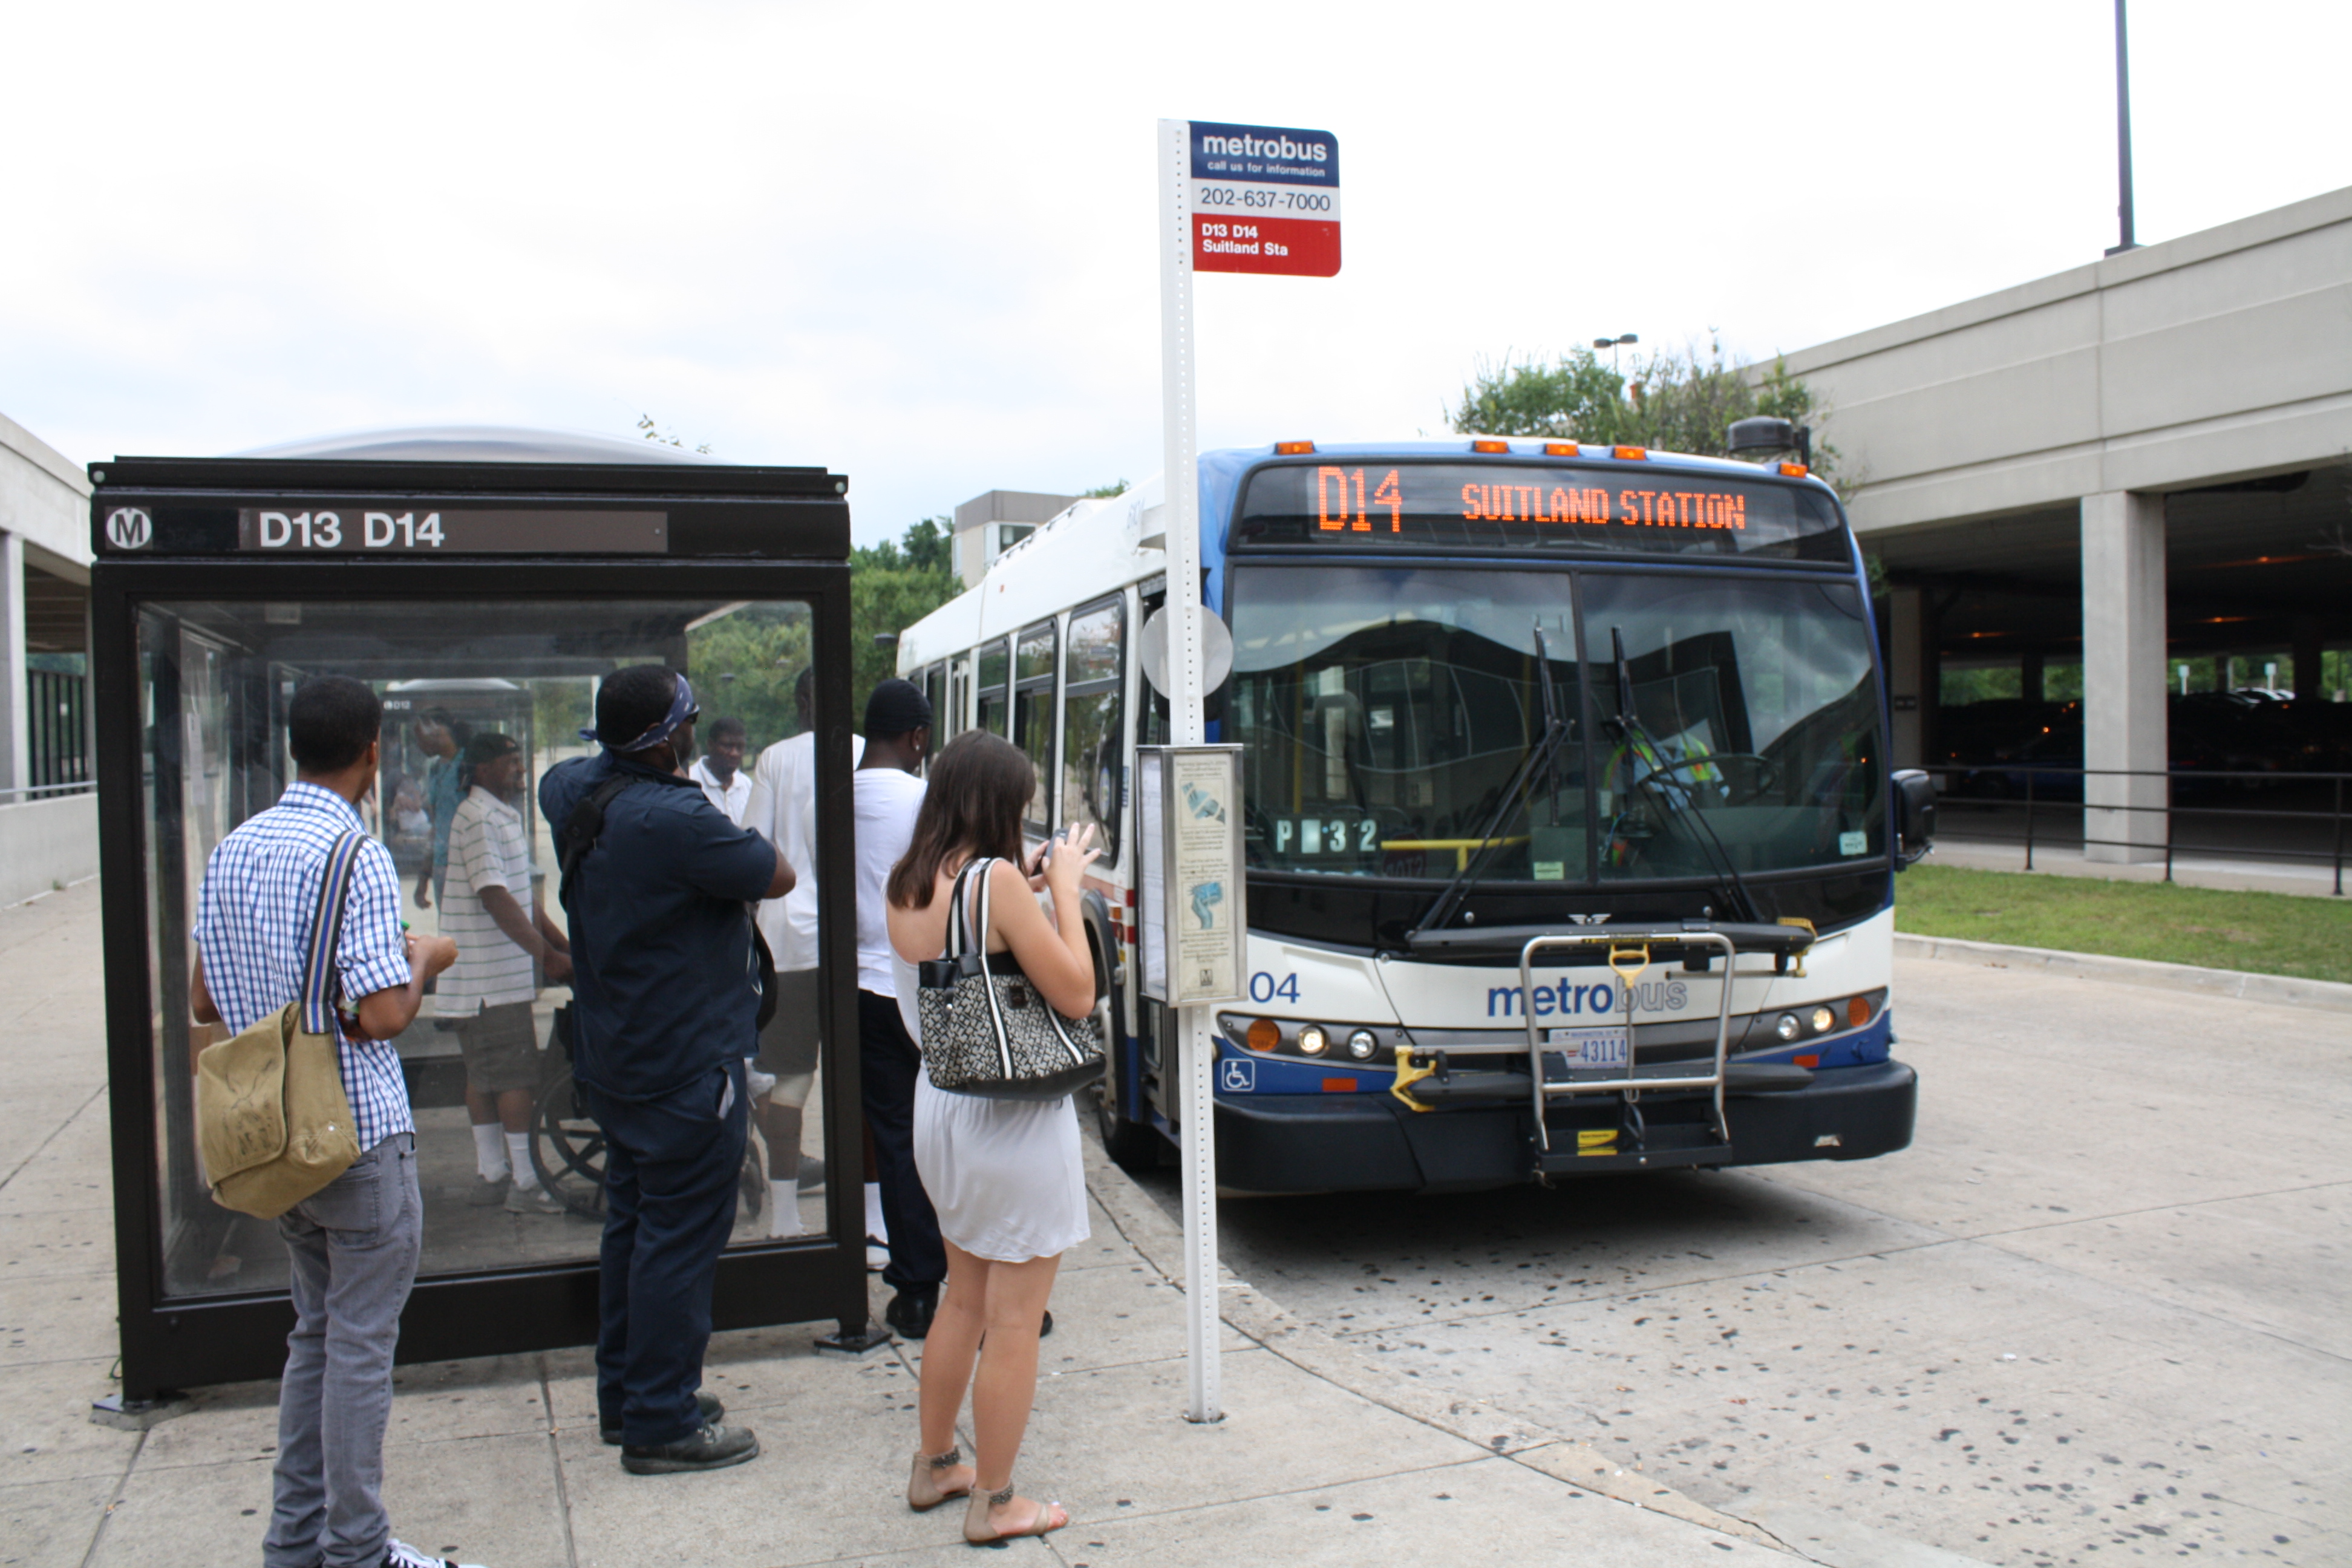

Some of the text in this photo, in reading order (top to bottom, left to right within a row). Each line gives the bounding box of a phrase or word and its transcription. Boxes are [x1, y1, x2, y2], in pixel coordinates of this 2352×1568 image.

[1203, 134, 1327, 161] metrobus
[1207, 161, 1325, 177] call us for information
[1201, 188, 1330, 211] 202-637-7000
[1202, 223, 1258, 238] D13 D14
[1203, 240, 1289, 256] Suitland Sta
[1318, 466, 1745, 533] D14 SUITLAND STATION
[260, 511, 342, 548] D13
[364, 512, 445, 547] D14
[1488, 976, 1688, 1016] metrobus
[1581, 1039, 1626, 1062] 43114
